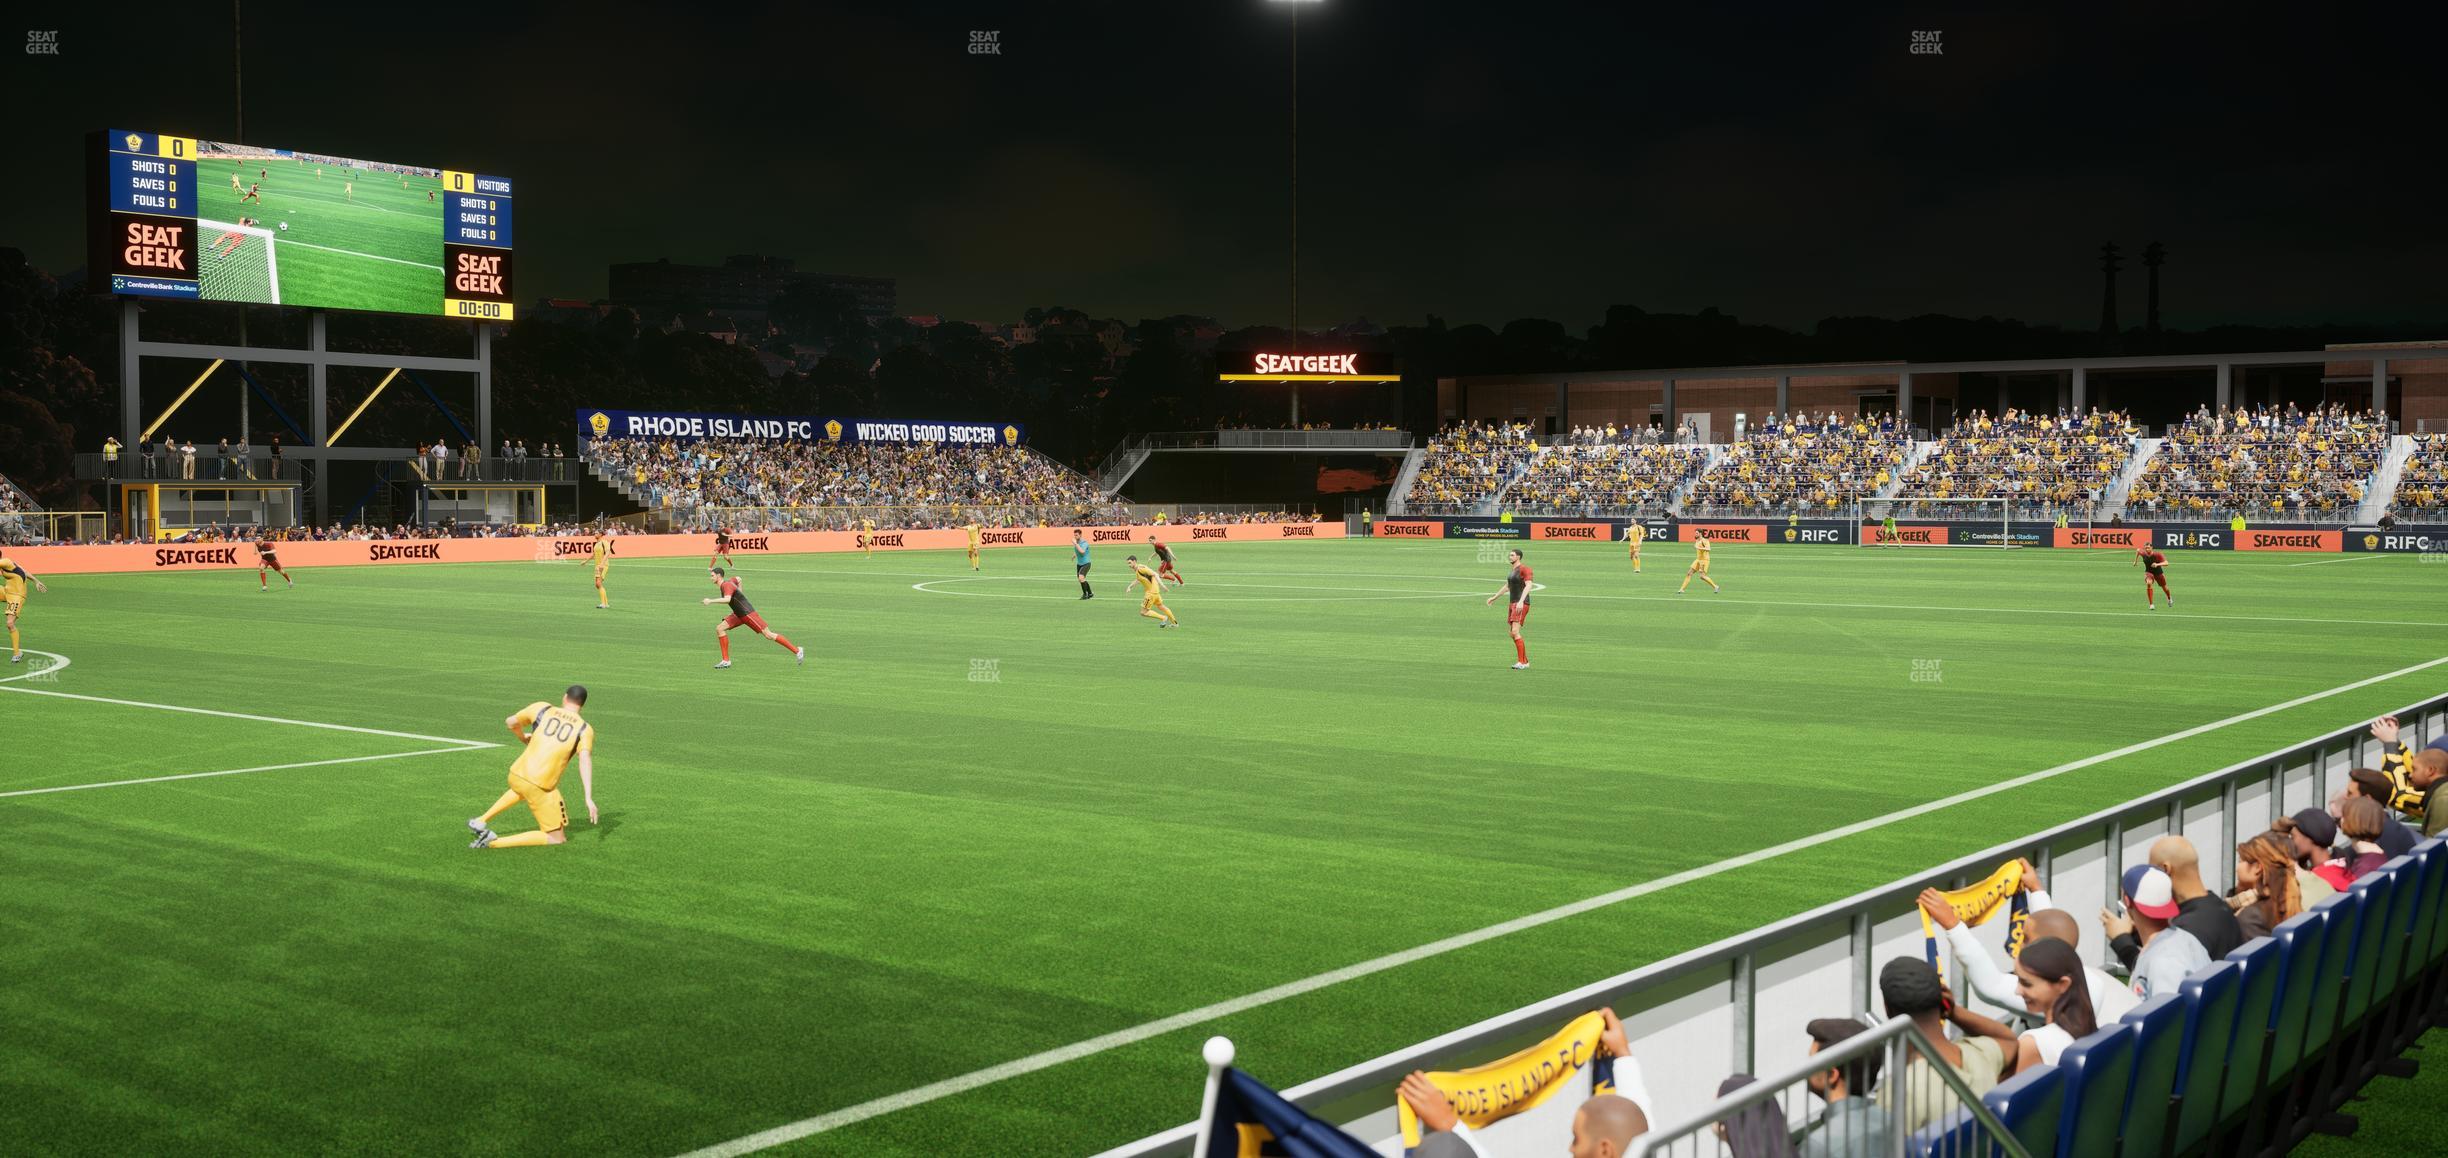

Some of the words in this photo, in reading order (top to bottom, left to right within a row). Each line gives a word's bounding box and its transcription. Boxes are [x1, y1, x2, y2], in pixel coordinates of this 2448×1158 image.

[132, 160, 165, 174] SHOTS
[169, 164, 176, 175] 0
[132, 177, 165, 191] SAVES
[169, 181, 176, 192] 0
[477, 179, 510, 192] VISITORS
[133, 194, 165, 208] FOULS
[169, 198, 176, 209] 0
[460, 197, 487, 210] SHOTS
[490, 200, 496, 211] 0
[461, 212, 487, 225] SAVES
[490, 215, 496, 226] 0
[127, 222, 183, 247] SEAT
[461, 227, 487, 240] FOULS
[490, 230, 496, 241] 0
[124, 245, 186, 271] GEEK
[457, 253, 502, 275] SEAT
[455, 273, 504, 296] GEEK
[459, 301, 500, 318] 00:00
[1255, 353, 1358, 375] SEATGEEK
[628, 416, 704, 437] RHODE
[708, 418, 784, 439] ISLAND
[787, 421, 812, 440] FC
[856, 423, 910, 442] WICKED
[911, 424, 947, 443] GOOD
[949, 426, 996, 444] SOCCER
[982, 531, 1024, 545] SEATGEEK
[1092, 529, 1131, 542] SEATGEEK
[1192, 527, 1227, 539] SEATGEEK
[1282, 525, 1314, 537] SEATGEEK
[1384, 524, 1430, 537] SEATGEEK
[1545, 525, 1596, 539] SEATGEEK
[1649, 527, 1667, 539] FC
[1701, 528, 1751, 541] EATGEEK
[1801, 529, 1839, 542] RIFC
[715, 536, 769, 551] ATGEEK
[2071, 531, 2134, 546] SEATGEEK
[2254, 533, 2322, 549] SEATGEEK
[2384, 535, 2429, 550] RIFC
[155, 547, 238, 566] SEATGEEK
[370, 543, 441, 561] SEATGEEK
[544, 717, 574, 743] 00
[1492, 1060, 1556, 1110] ISLAND
[1559, 1039, 1586, 1070] FC
